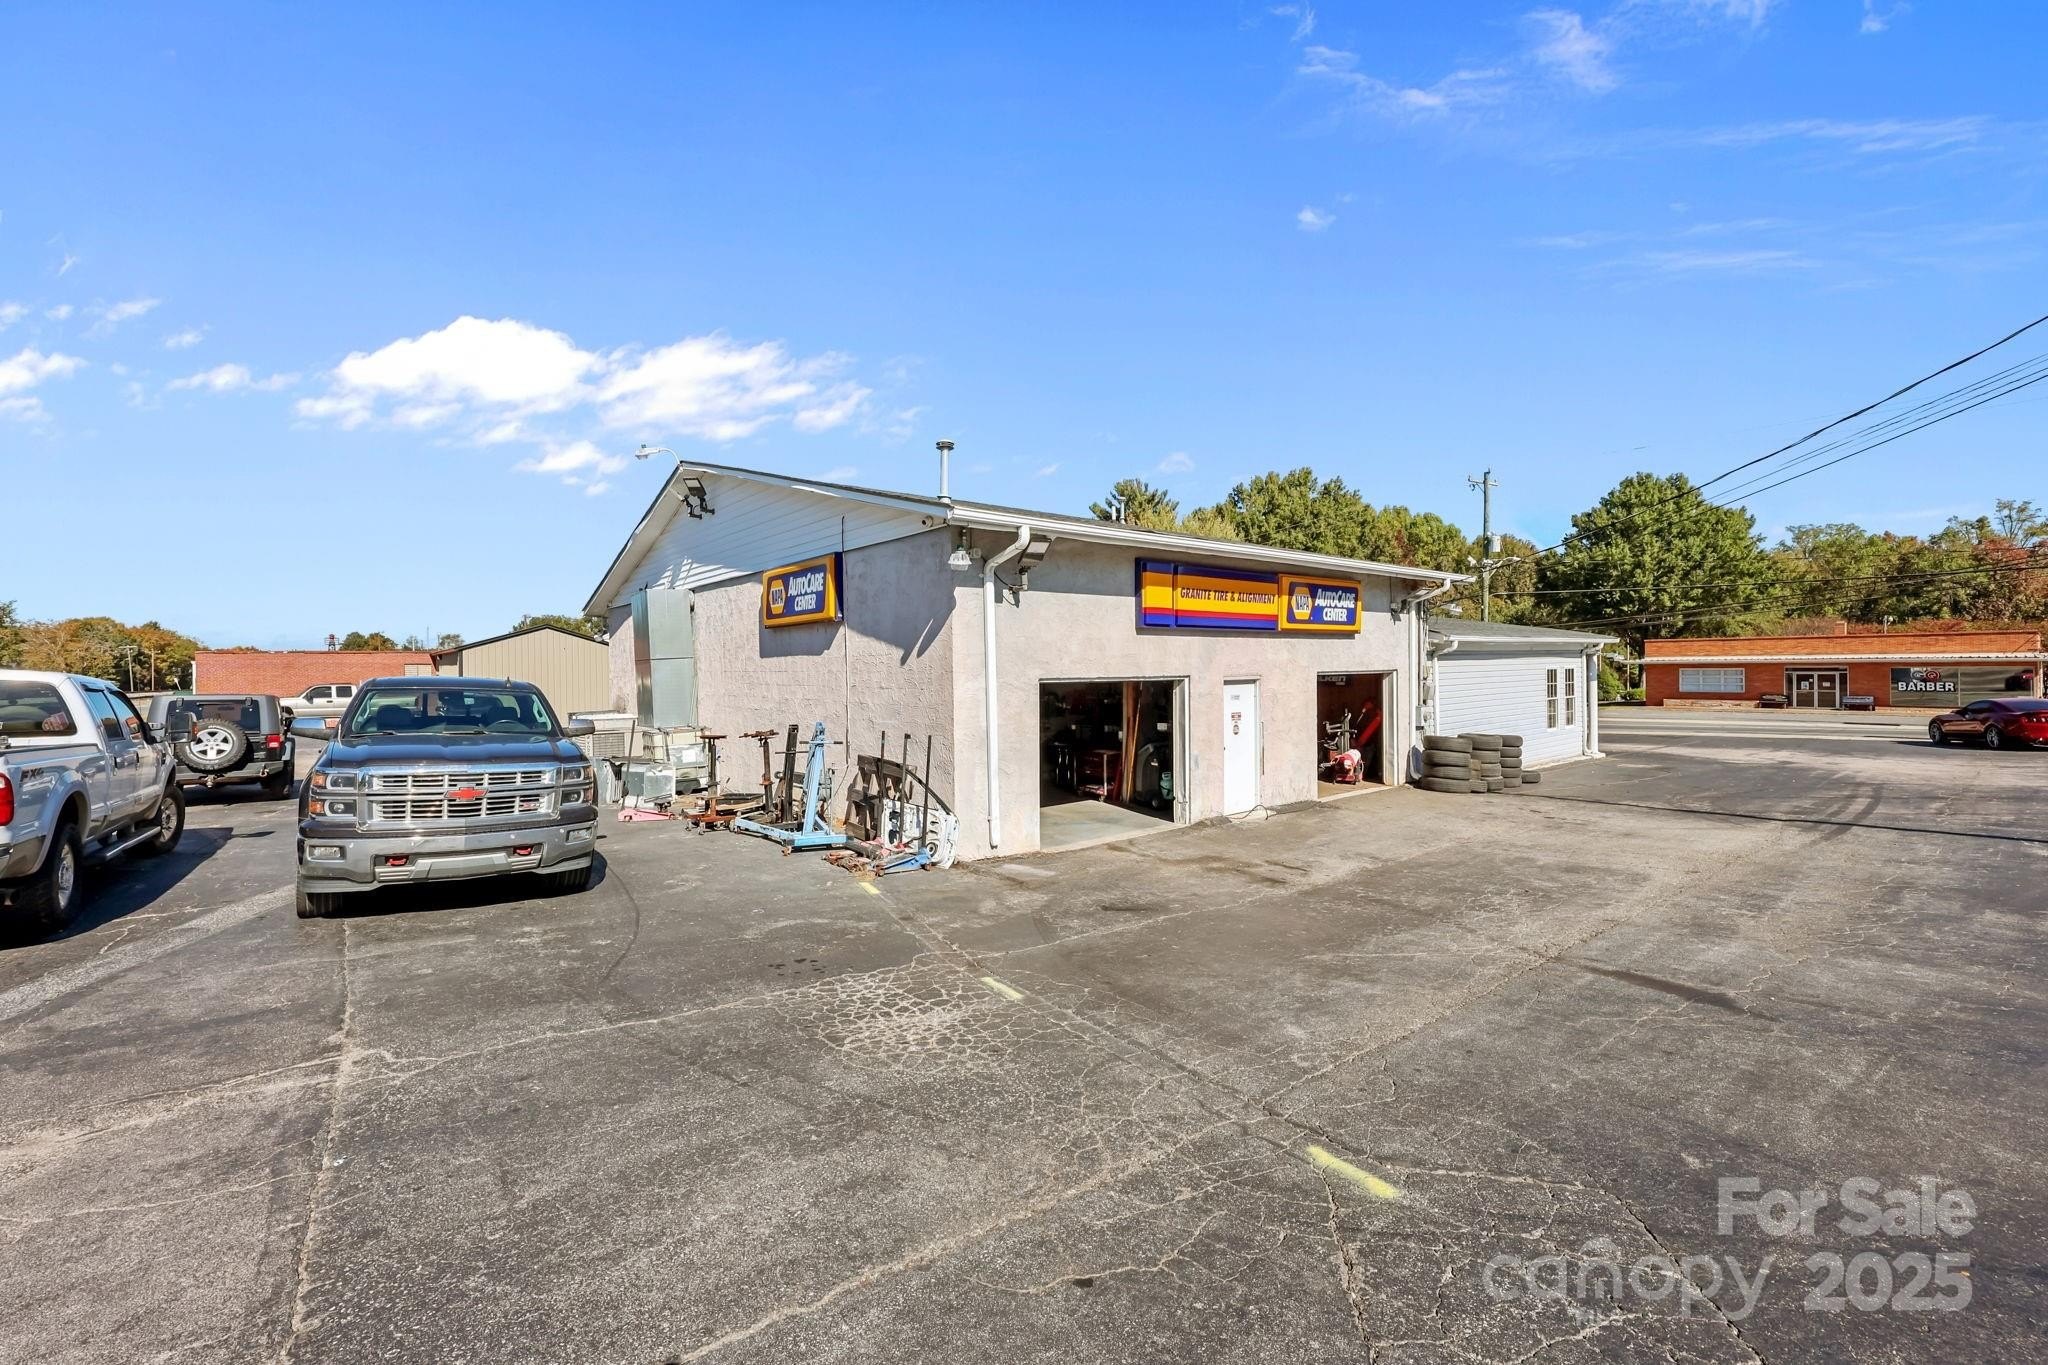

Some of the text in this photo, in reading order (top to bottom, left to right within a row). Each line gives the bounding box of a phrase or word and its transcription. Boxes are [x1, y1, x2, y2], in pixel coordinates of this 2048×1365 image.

[795, 594, 816, 611] CENTER
[1180, 587, 1276, 604] GRANITE TIRE & ALIGNMENT
[1296, 594, 1309, 611] NAPA
[1322, 607, 1348, 622] CENTER
[1898, 682, 1955, 692] BARBER
